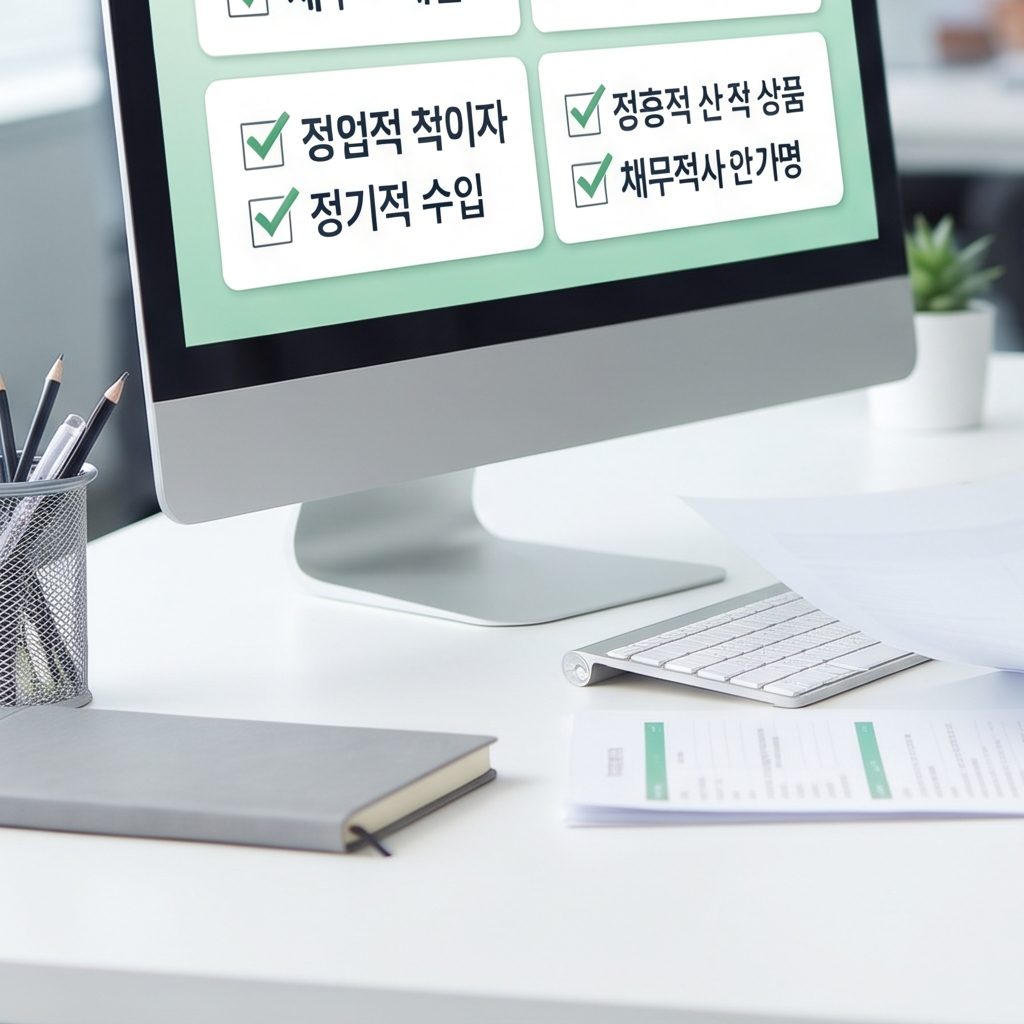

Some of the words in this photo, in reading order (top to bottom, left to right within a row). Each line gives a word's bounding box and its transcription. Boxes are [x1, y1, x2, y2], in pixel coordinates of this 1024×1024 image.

[758, 76, 804, 116] 상품
[302, 109, 402, 162] 정업적
[311, 181, 410, 237] 정기적
[423, 173, 484, 224] 수입
